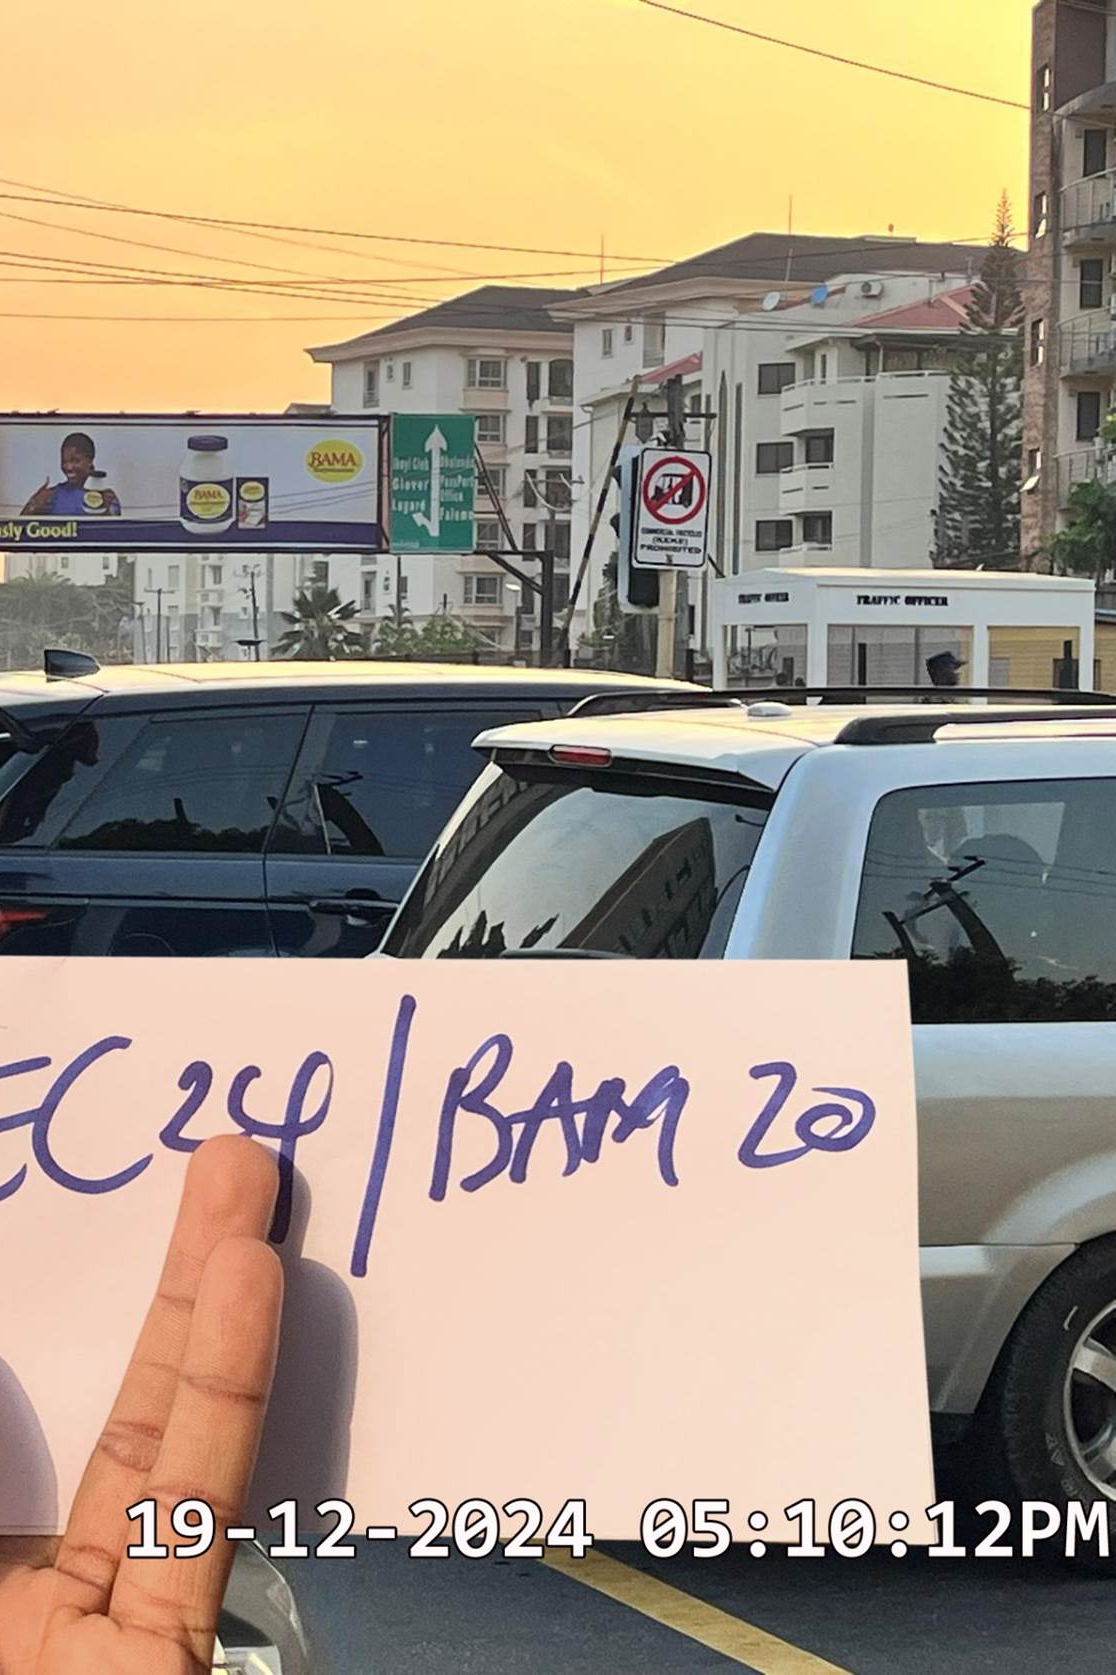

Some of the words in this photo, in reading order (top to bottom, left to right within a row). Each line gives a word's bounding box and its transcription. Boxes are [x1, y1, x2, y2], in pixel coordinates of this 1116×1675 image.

[307, 451, 357, 467] BAMA
[392, 477, 429, 491] Glover
[26, 521, 78, 538] Good!
[856, 595, 901, 606] TRAFFIC
[904, 596, 949, 606] OFFICER
